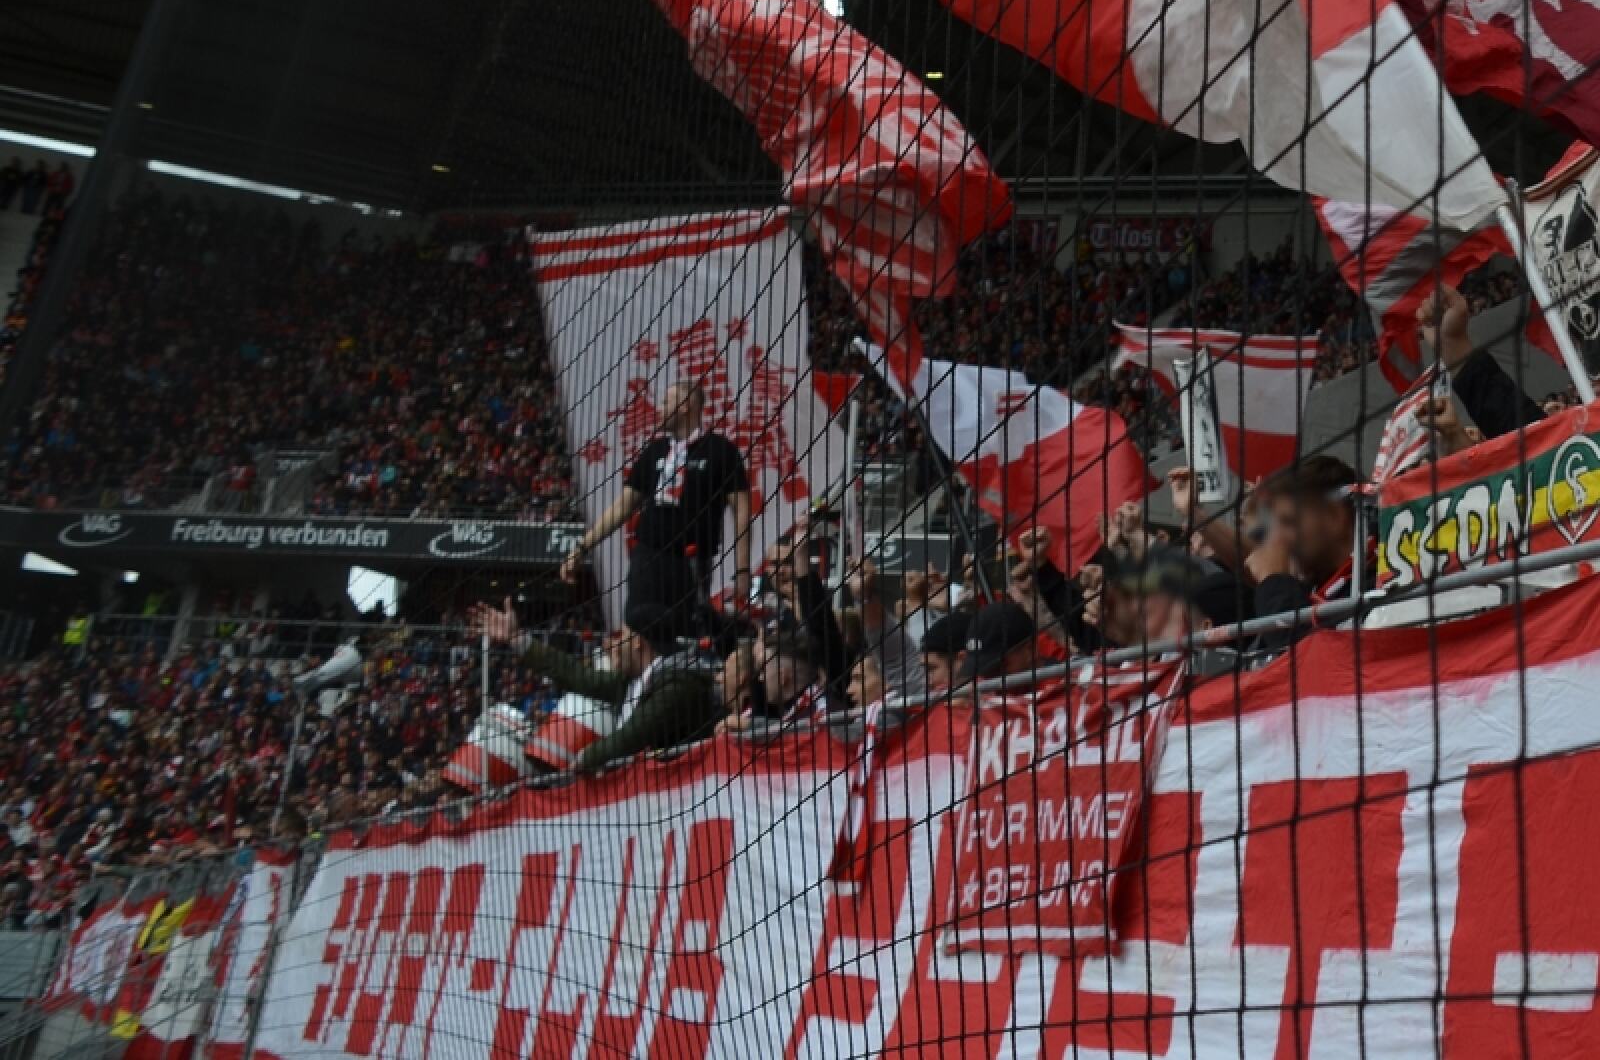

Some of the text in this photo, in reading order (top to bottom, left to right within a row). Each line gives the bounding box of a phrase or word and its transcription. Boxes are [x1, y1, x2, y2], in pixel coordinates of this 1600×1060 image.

[171, 517, 265, 549] Freiburg
[269, 520, 390, 548] verbunden
[966, 791, 1028, 852] FÜR
